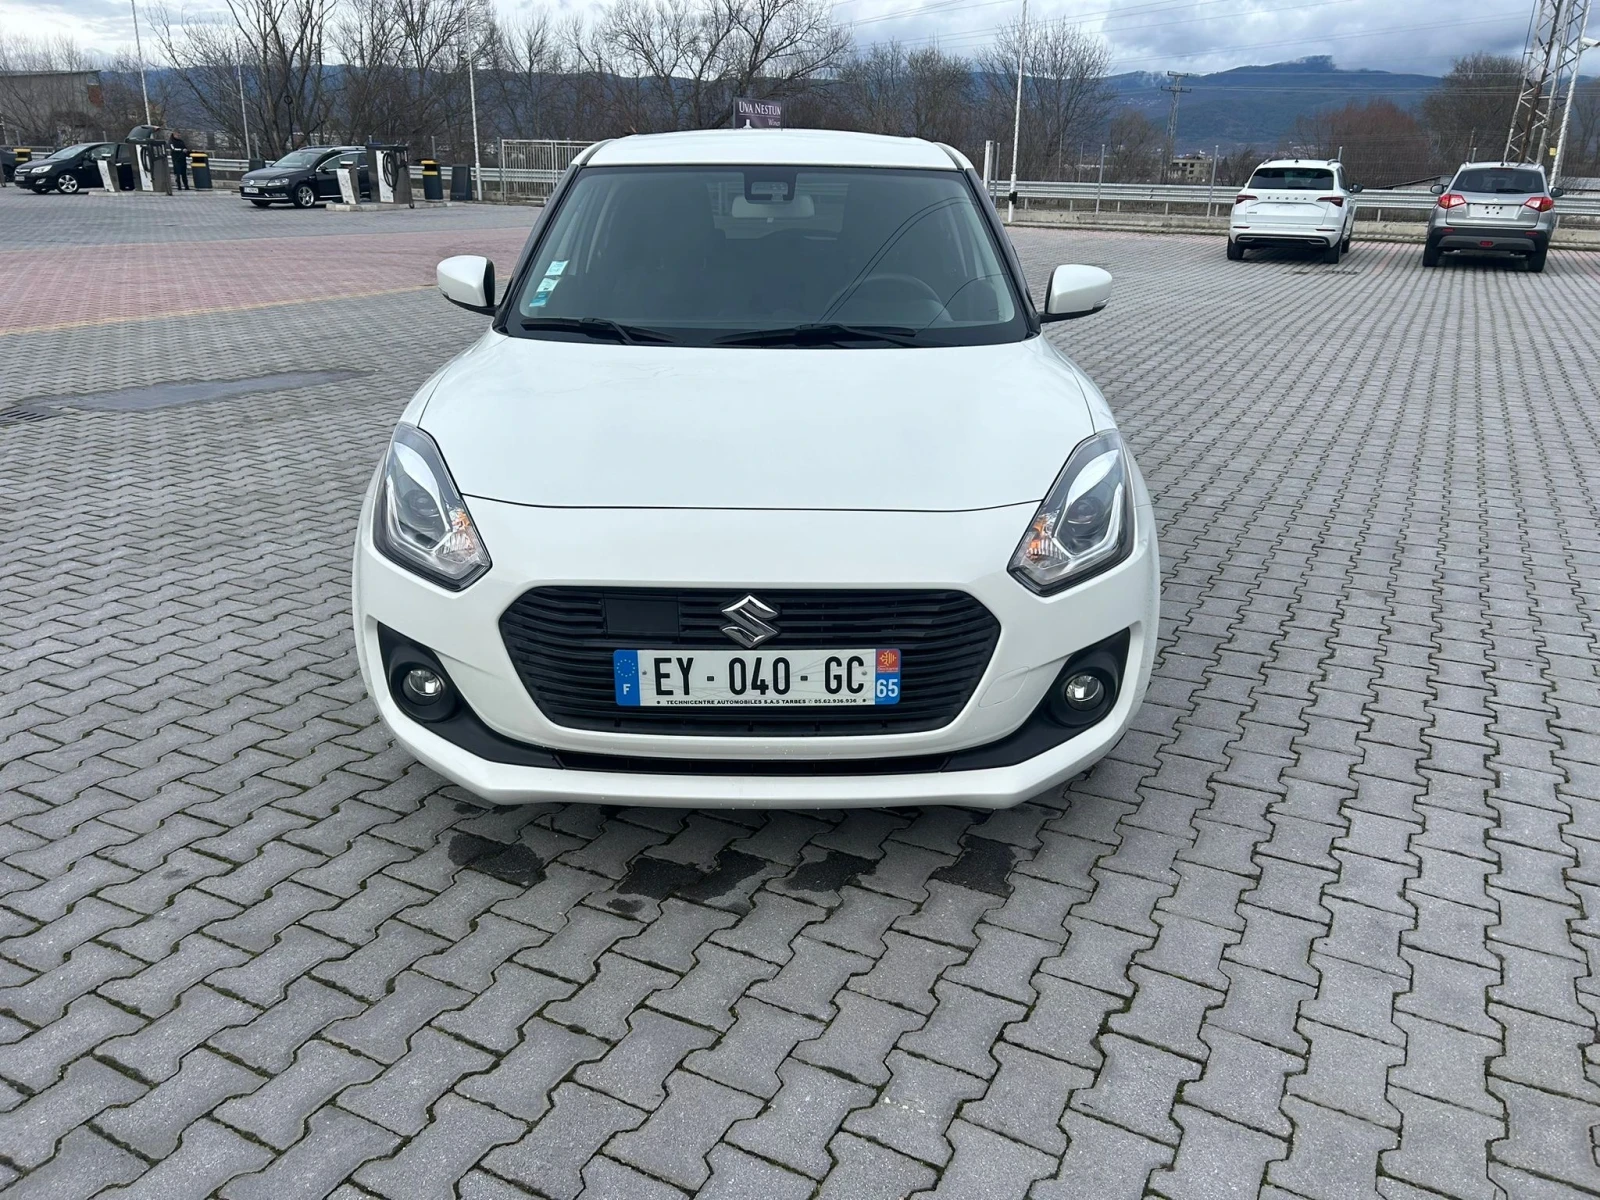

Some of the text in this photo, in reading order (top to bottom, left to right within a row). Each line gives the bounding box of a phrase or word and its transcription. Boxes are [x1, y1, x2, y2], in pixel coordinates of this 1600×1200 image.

[739, 101, 754, 114] UVA
[653, 657, 694, 696] EY
[728, 657, 790, 696] 040
[824, 655, 865, 695] GC
[622, 683, 631, 695] F
[876, 678, 899, 698] 65
